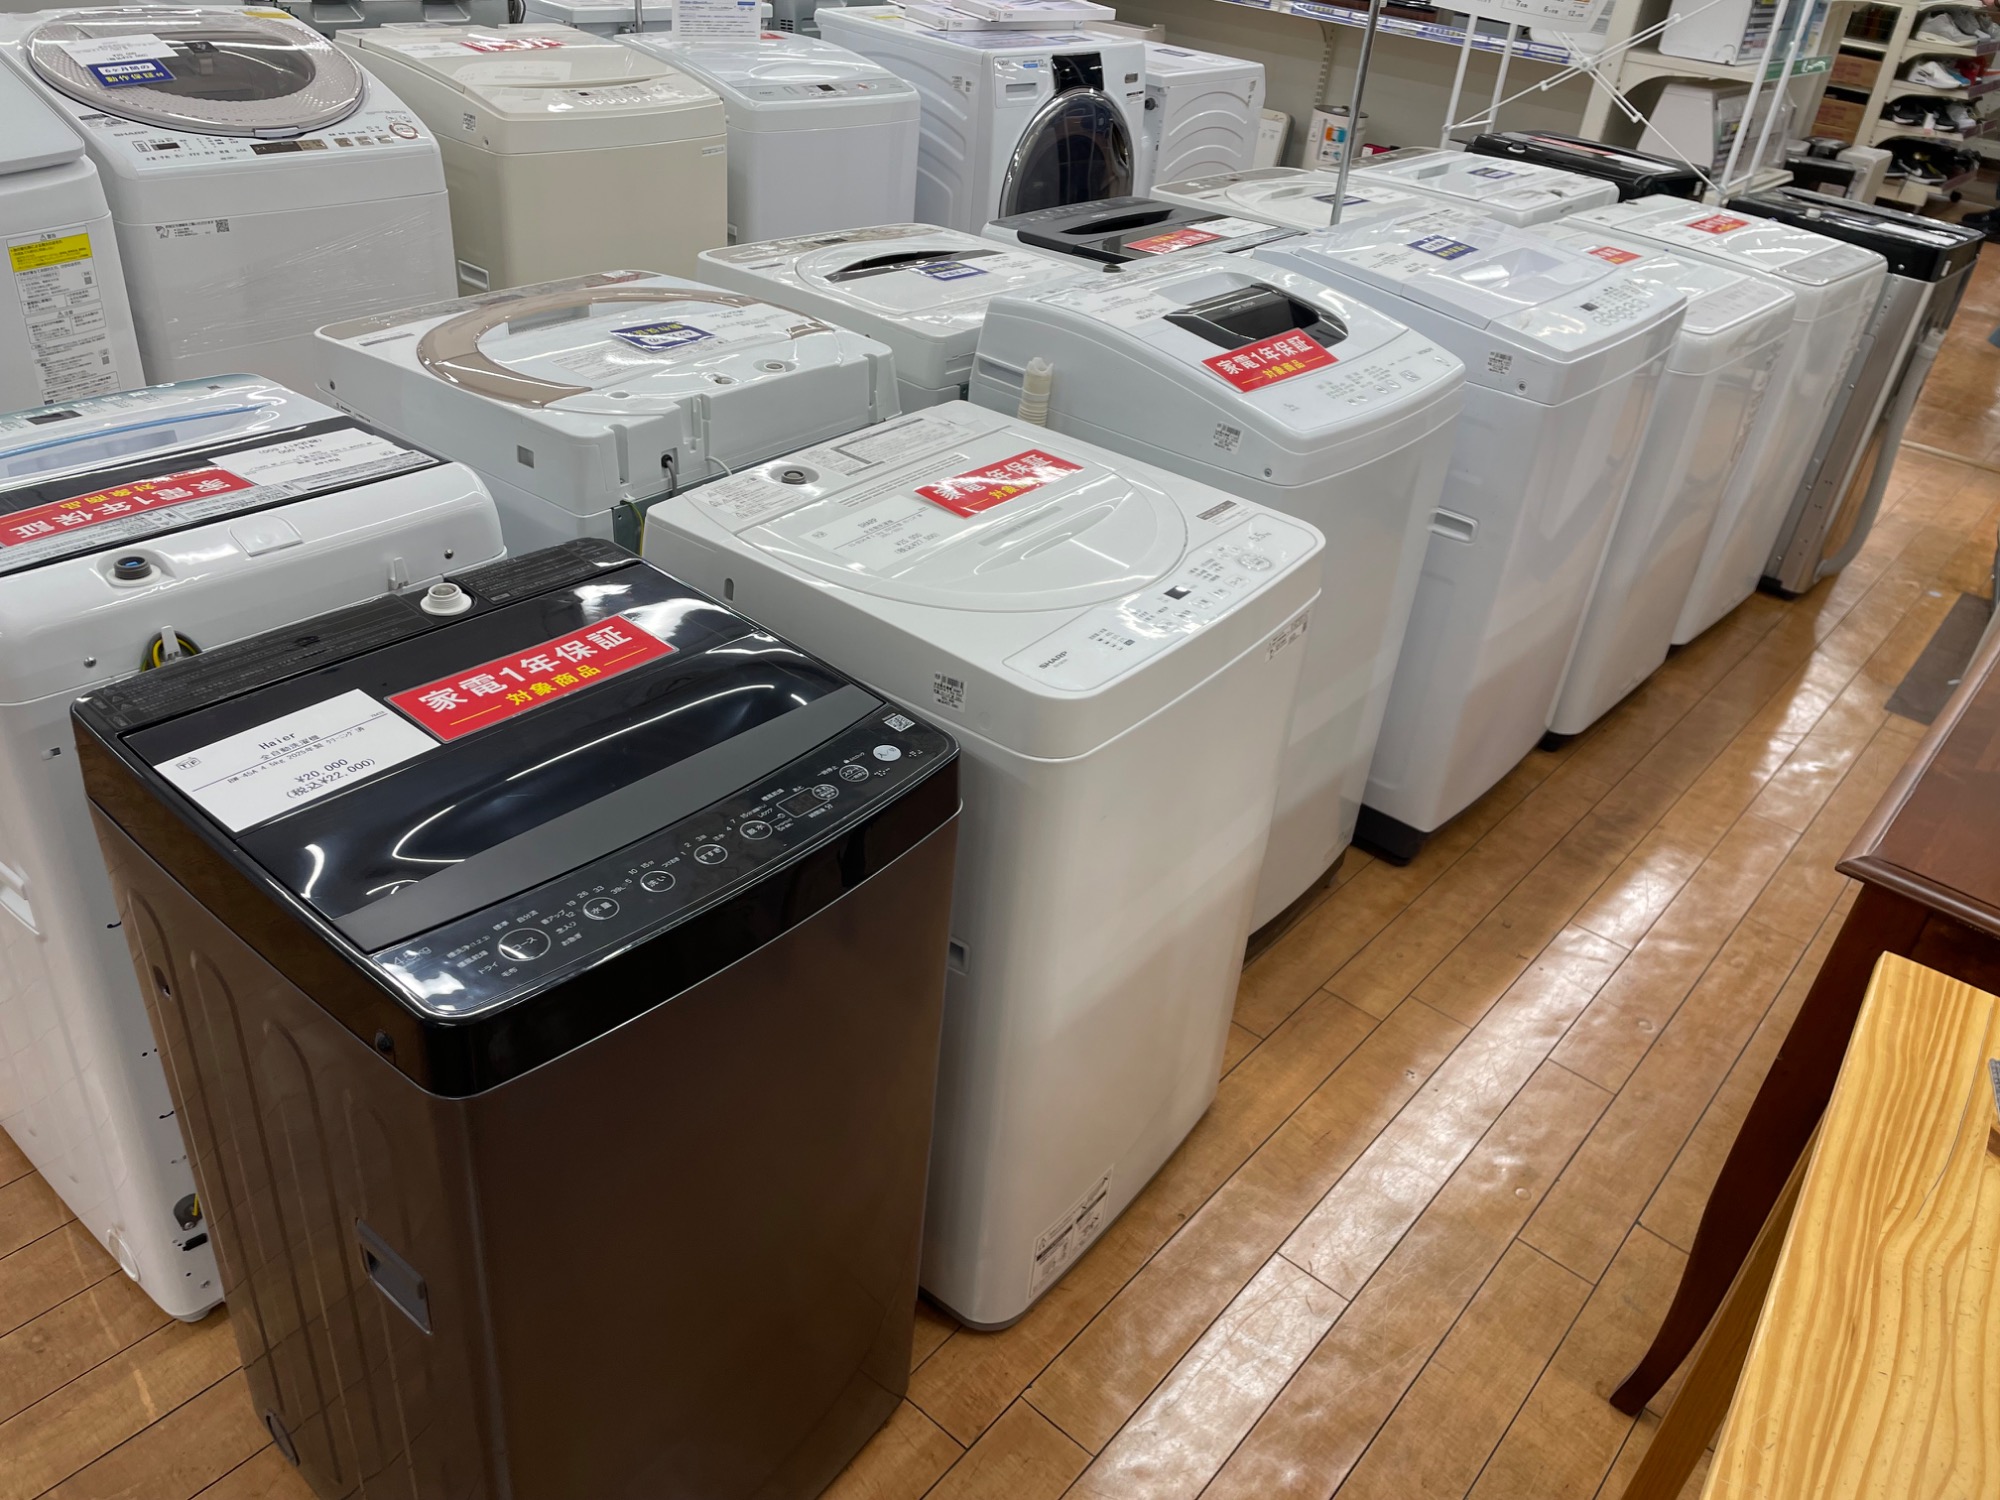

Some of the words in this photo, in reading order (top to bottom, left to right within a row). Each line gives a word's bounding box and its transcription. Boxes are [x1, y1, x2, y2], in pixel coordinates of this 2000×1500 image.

[105, 72, 164, 83] 動作保証付
[1216, 336, 1314, 376] 家電1年保証
[1262, 359, 1306, 380] 対象商品
[933, 454, 1052, 501] 家電年保証
[59, 482, 158, 510] 対象商品
[9, 478, 231, 539] 家電1年保証
[418, 626, 632, 713] 家電1年保証
[1038, 651, 1068, 669] SHARP
[505, 664, 602, 706] 対象商品
[258, 732, 296, 751] Haier
[260, 734, 320, 762] 全自動洗濯機
[286, 758, 376, 800] (税込¥22,000)
[294, 758, 348, 784] ¥20,000
[698, 846, 722, 860] すすぎ
[576, 890, 589, 898] 26
[592, 885, 604, 894] 33
[647, 875, 668, 888] 洗い
[478, 961, 499, 974] ドライ
[501, 967, 518, 978] 毛布
